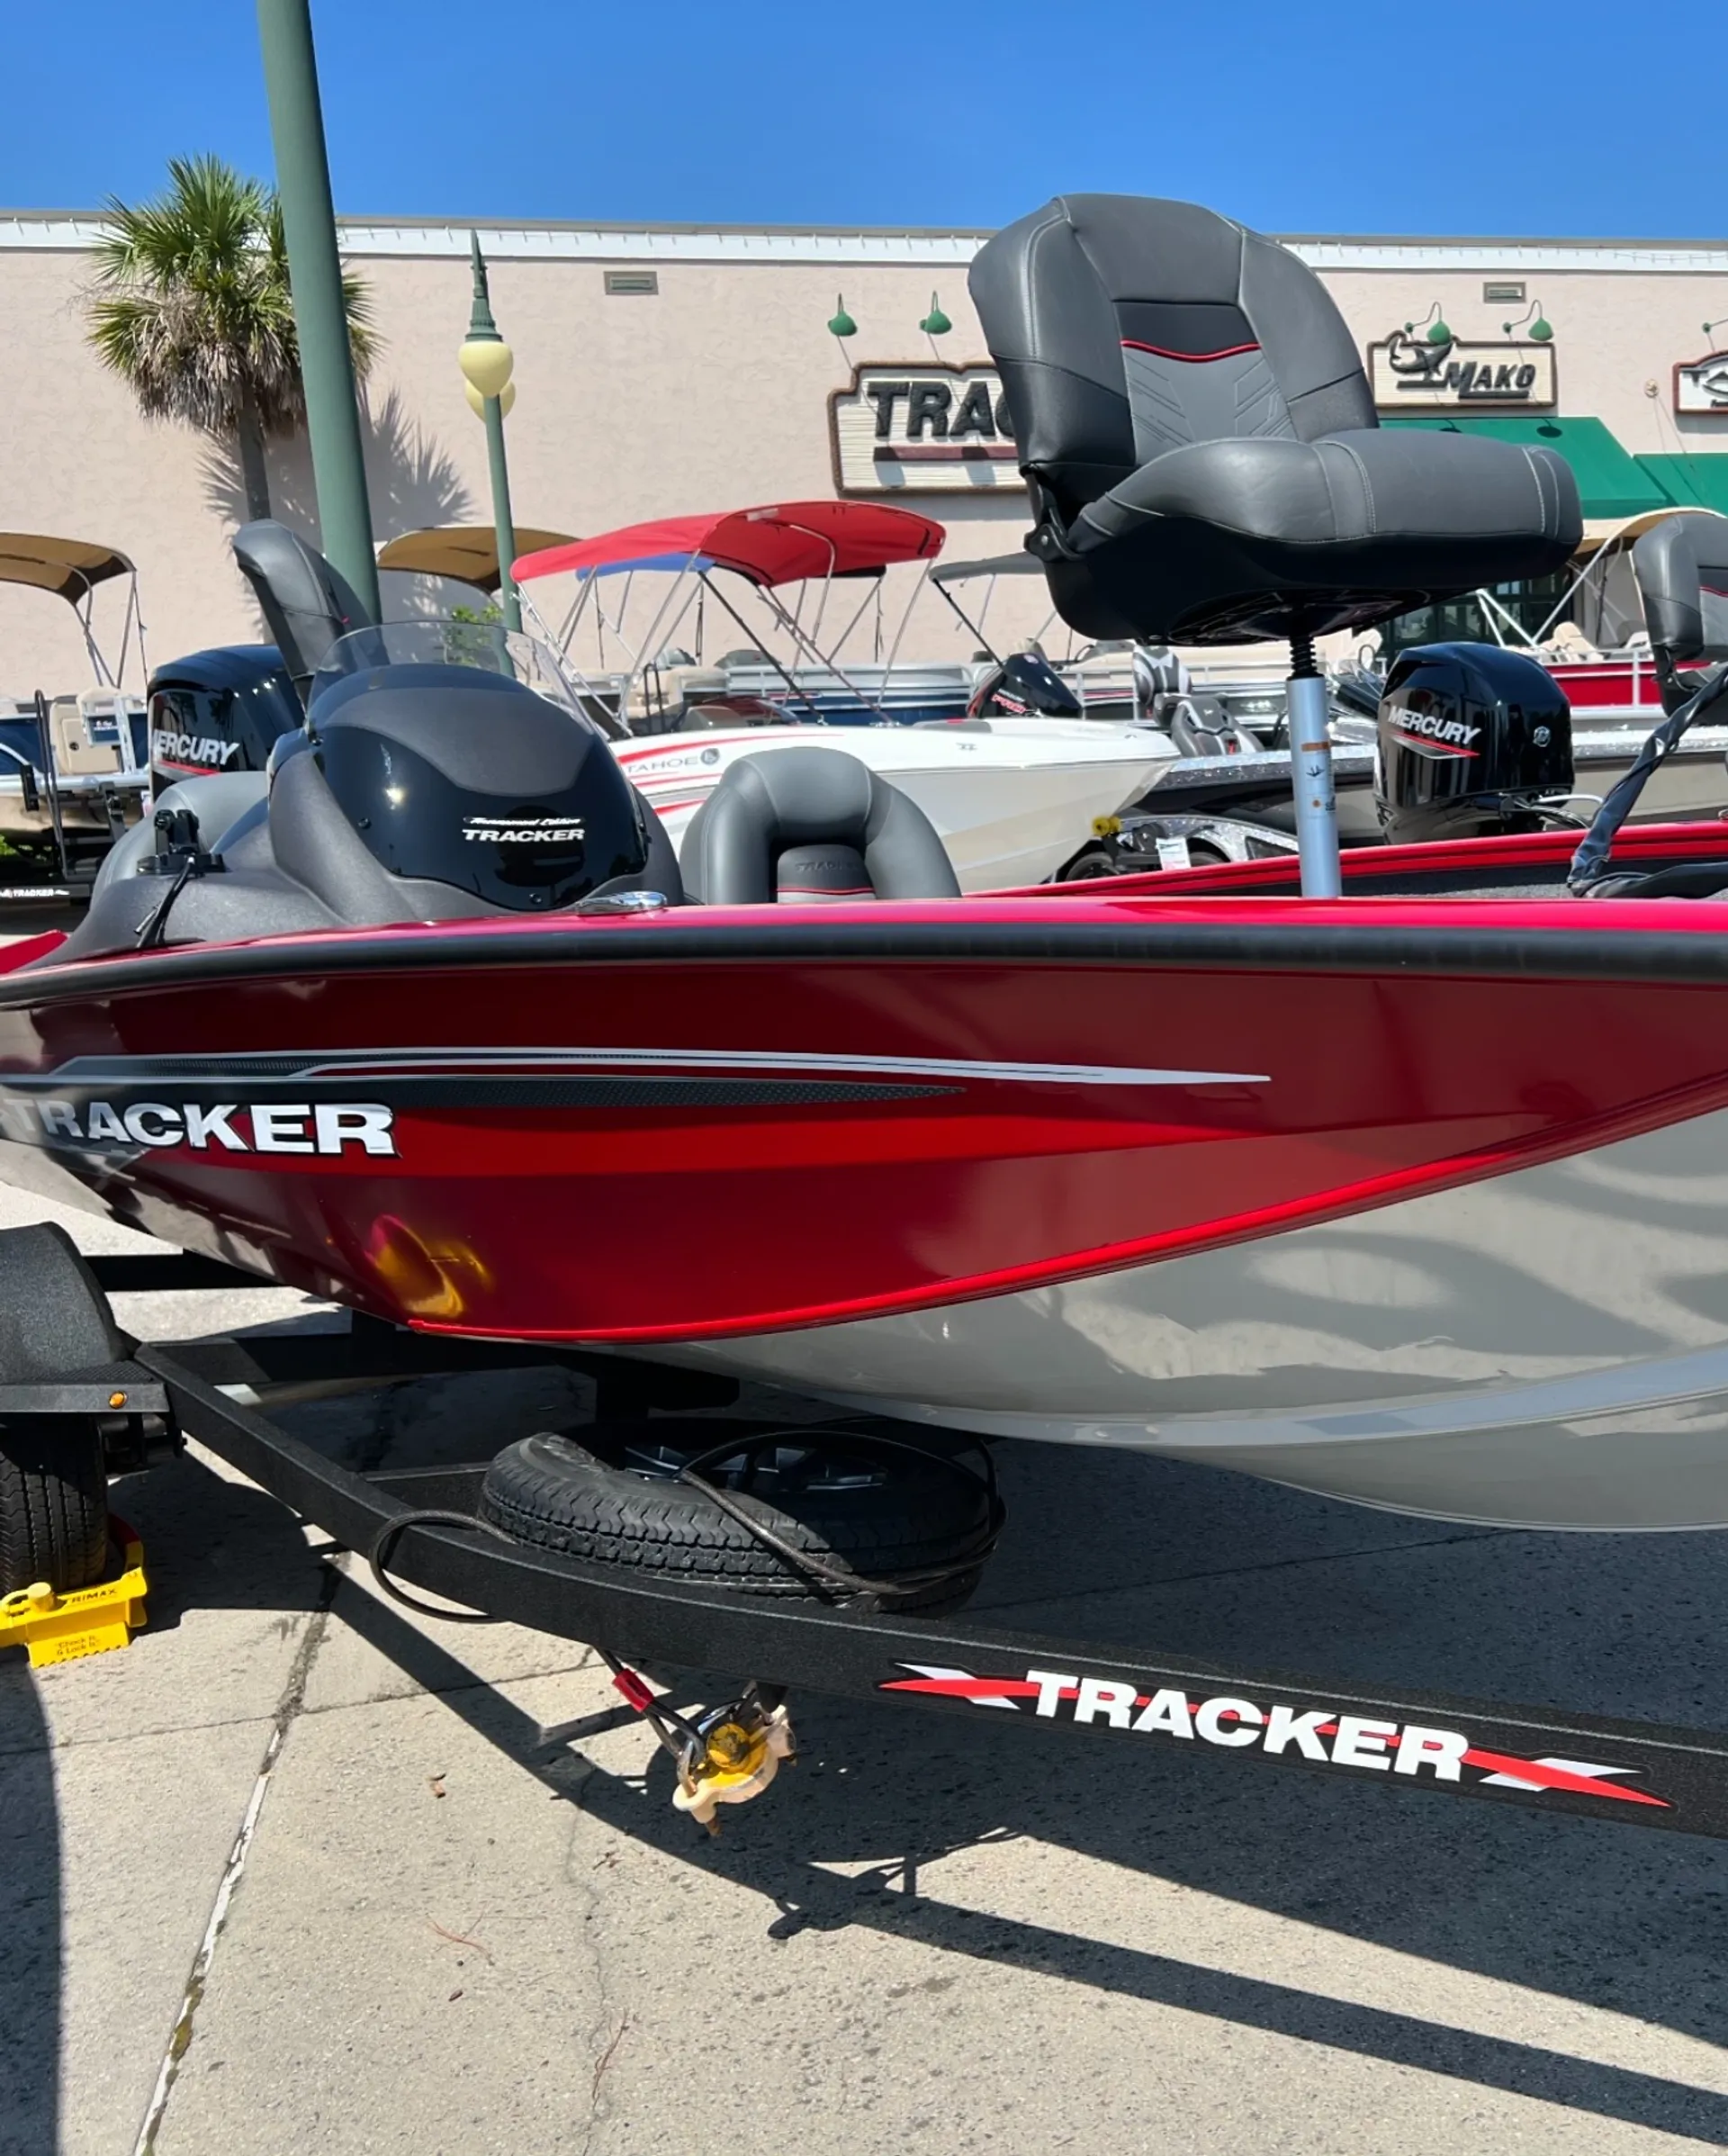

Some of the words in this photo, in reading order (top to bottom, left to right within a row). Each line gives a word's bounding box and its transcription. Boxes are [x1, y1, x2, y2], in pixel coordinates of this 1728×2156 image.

[1444, 361, 1536, 394] MAKO
[1388, 705, 1482, 745] MERCURY
[626, 756, 698, 772] TAHOE
[462, 828, 586, 843] TRACKER
[3, 1098, 398, 1156] TRACKER
[1025, 1669, 1470, 1782] TRACKER
